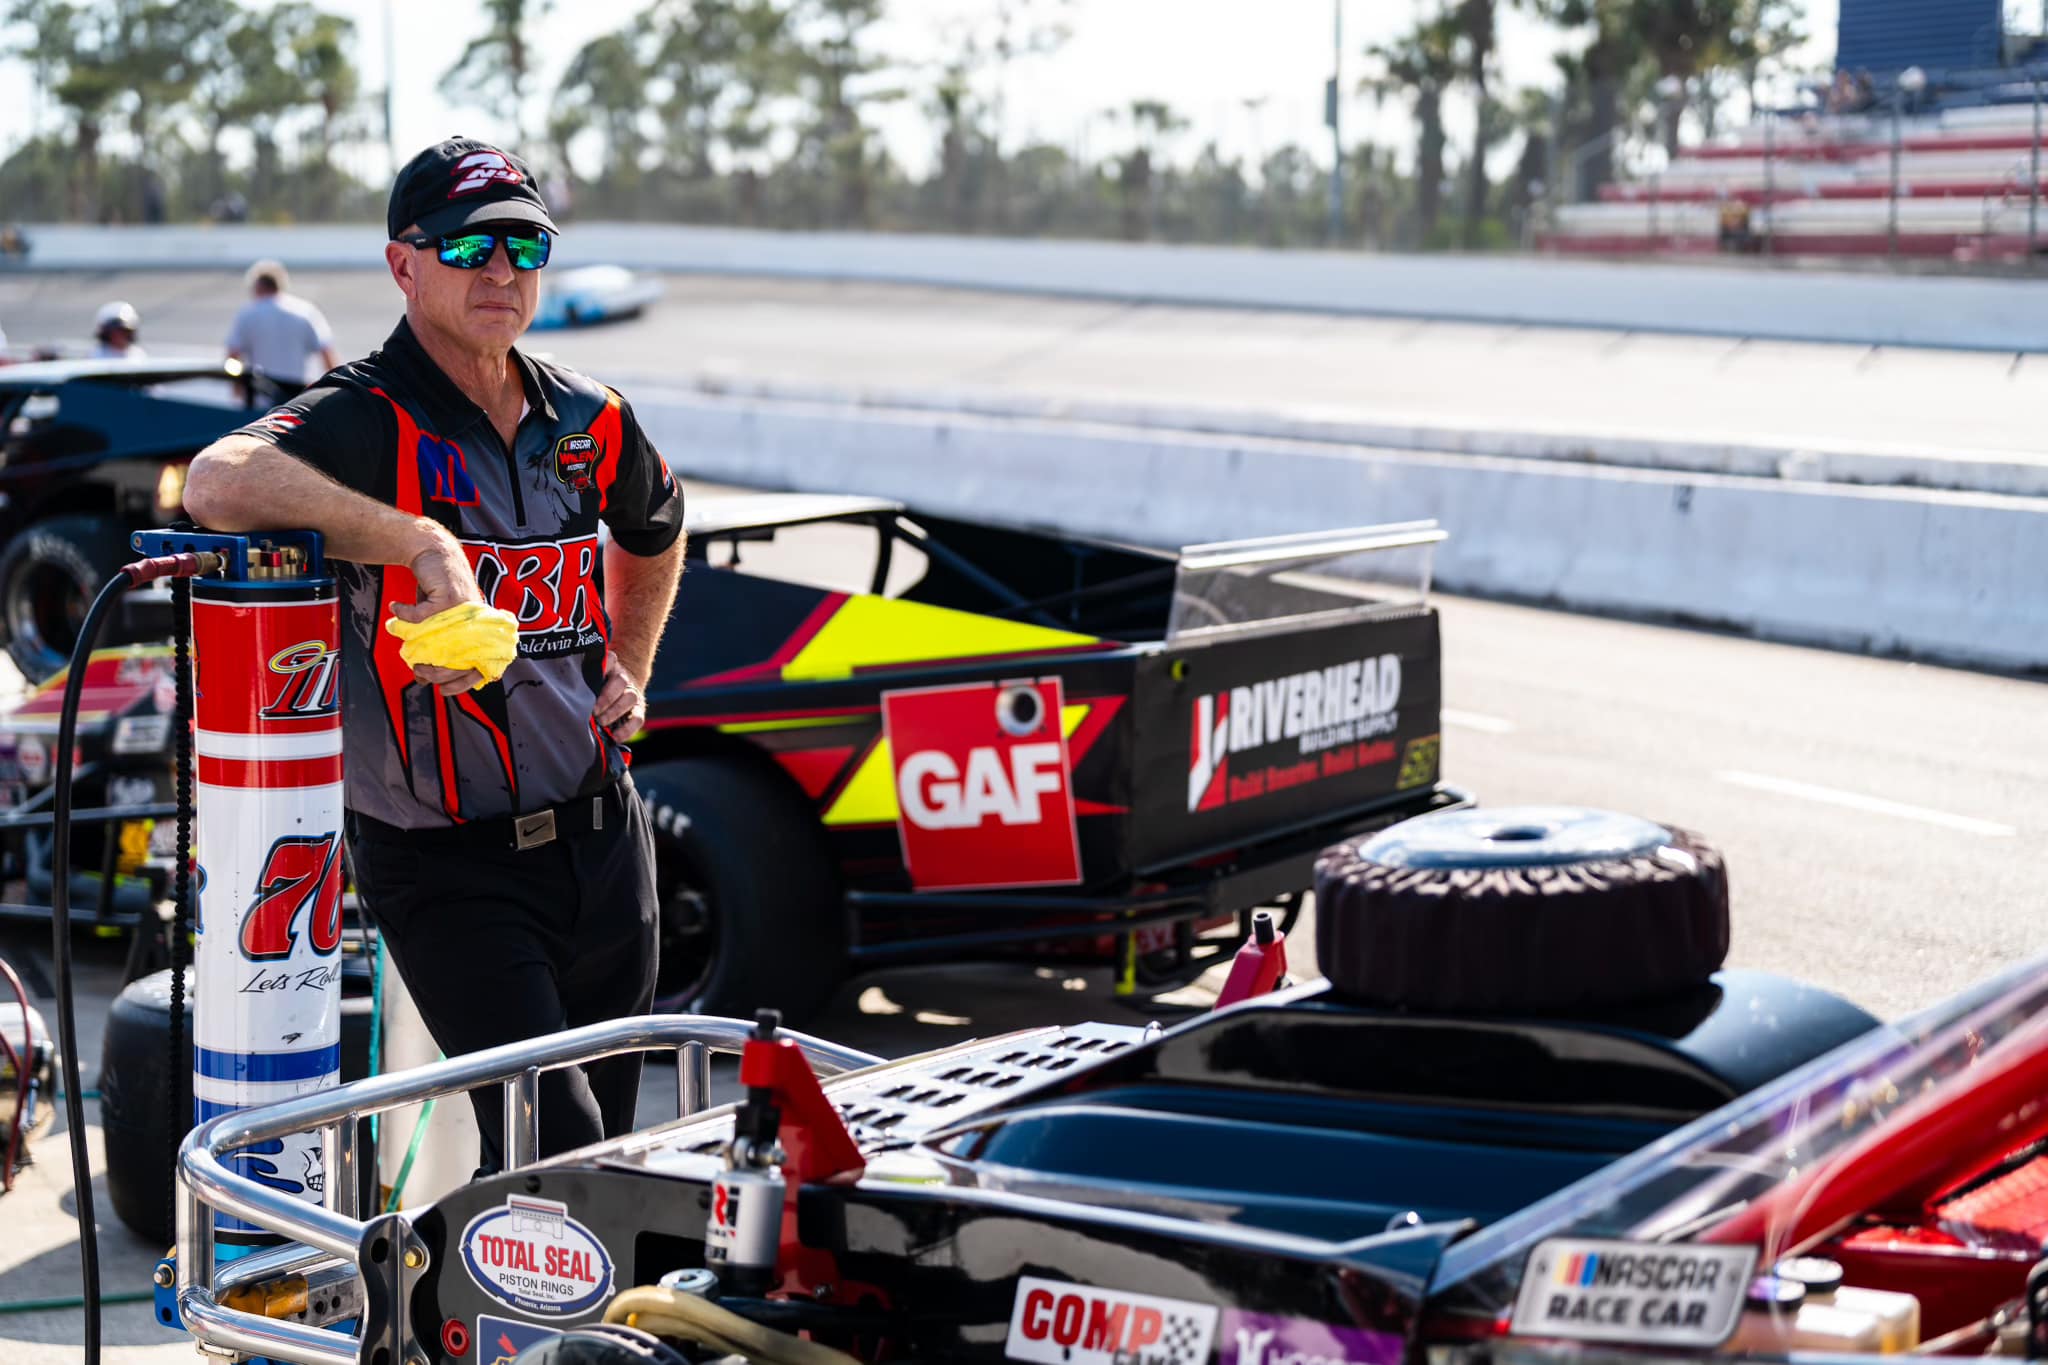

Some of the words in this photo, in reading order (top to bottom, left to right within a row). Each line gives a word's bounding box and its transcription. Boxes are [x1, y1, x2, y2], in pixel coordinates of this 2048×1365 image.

[518, 635, 572, 653] aldwin
[1229, 653, 1401, 753] RIVERHEAD
[899, 742, 1062, 830] GAF
[478, 1234, 540, 1273] TOTAL
[544, 1245, 596, 1283] SEAL
[1595, 1252, 1722, 1291] NASCAR
[499, 1273, 538, 1291] PISTON
[541, 1280, 574, 1297] RINGS
[1021, 1288, 1163, 1353] COMP
[1547, 1294, 1629, 1323] RACE
[1640, 1301, 1708, 1327] CAR
